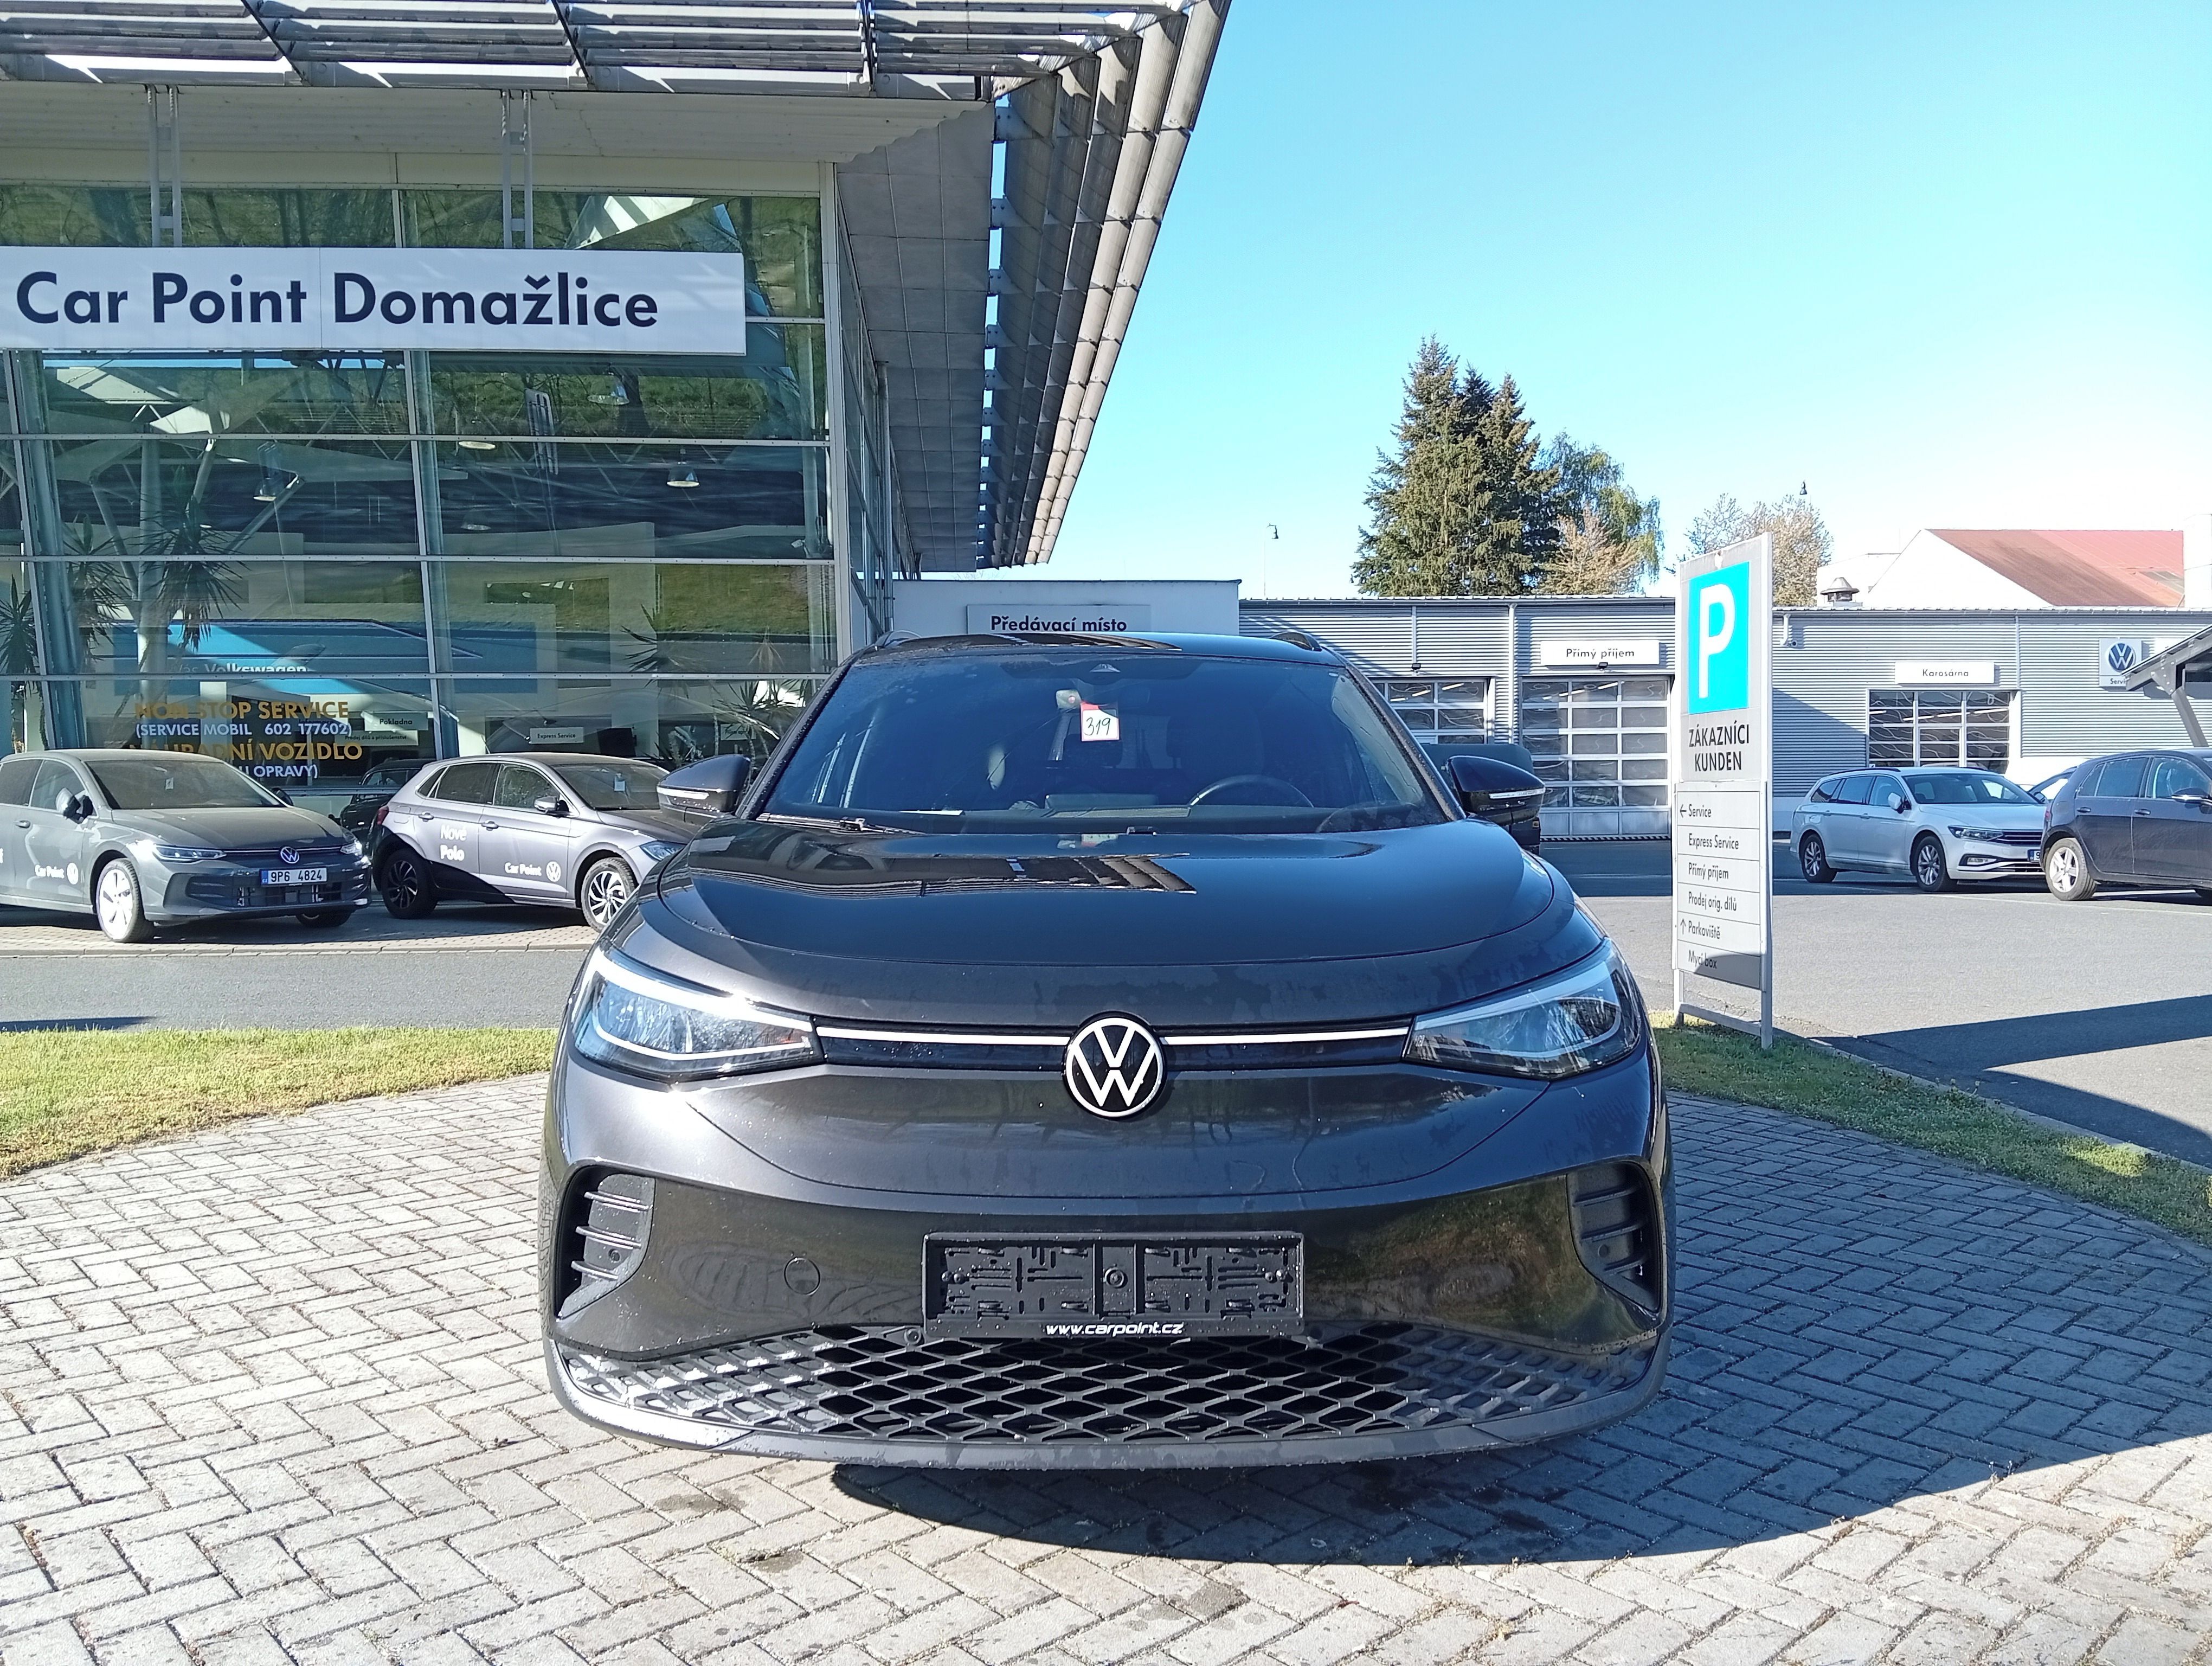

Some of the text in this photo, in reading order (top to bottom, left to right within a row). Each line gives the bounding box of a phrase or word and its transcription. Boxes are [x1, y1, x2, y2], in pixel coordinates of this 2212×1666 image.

[16, 271, 658, 327] Car Point Domažlice
[991, 616, 1127, 632] Předávací místo
[1698, 583, 1735, 699] P
[1566, 648, 1635, 659] Přímý příjem
[1922, 669, 1969, 677] Karosárna
[200, 701, 252, 719] STOP
[258, 701, 349, 719] SERVICE
[136, 722, 352, 738] (SERVICE MOBIL 602 177602)
[1084, 717, 1111, 736] 319
[1688, 720, 1750, 748] ZÁKAZNÍCI
[258, 742, 363, 760] VOZIDLO
[1694, 751, 1742, 772] KUNDEN
[253, 764, 318, 779] OPRAVY)
[1688, 804, 1712, 818] Service
[440, 825, 467, 841] Nové
[1688, 832, 1739, 850] Express Service
[440, 844, 465, 861] Polo
[271, 871, 290, 882] 9P6
[298, 869, 322, 881] 4824
[505, 862, 519, 874] Car
[519, 863, 542, 876] Point
[1688, 862, 1729, 881] Přímý příjem
[1688, 892, 1737, 913] Prodej orig. dílů
[1688, 920, 1720, 939] Parkoviště
[1704, 952, 1718, 970] box
[1046, 1322, 1184, 1337] www.carpoint.cz
